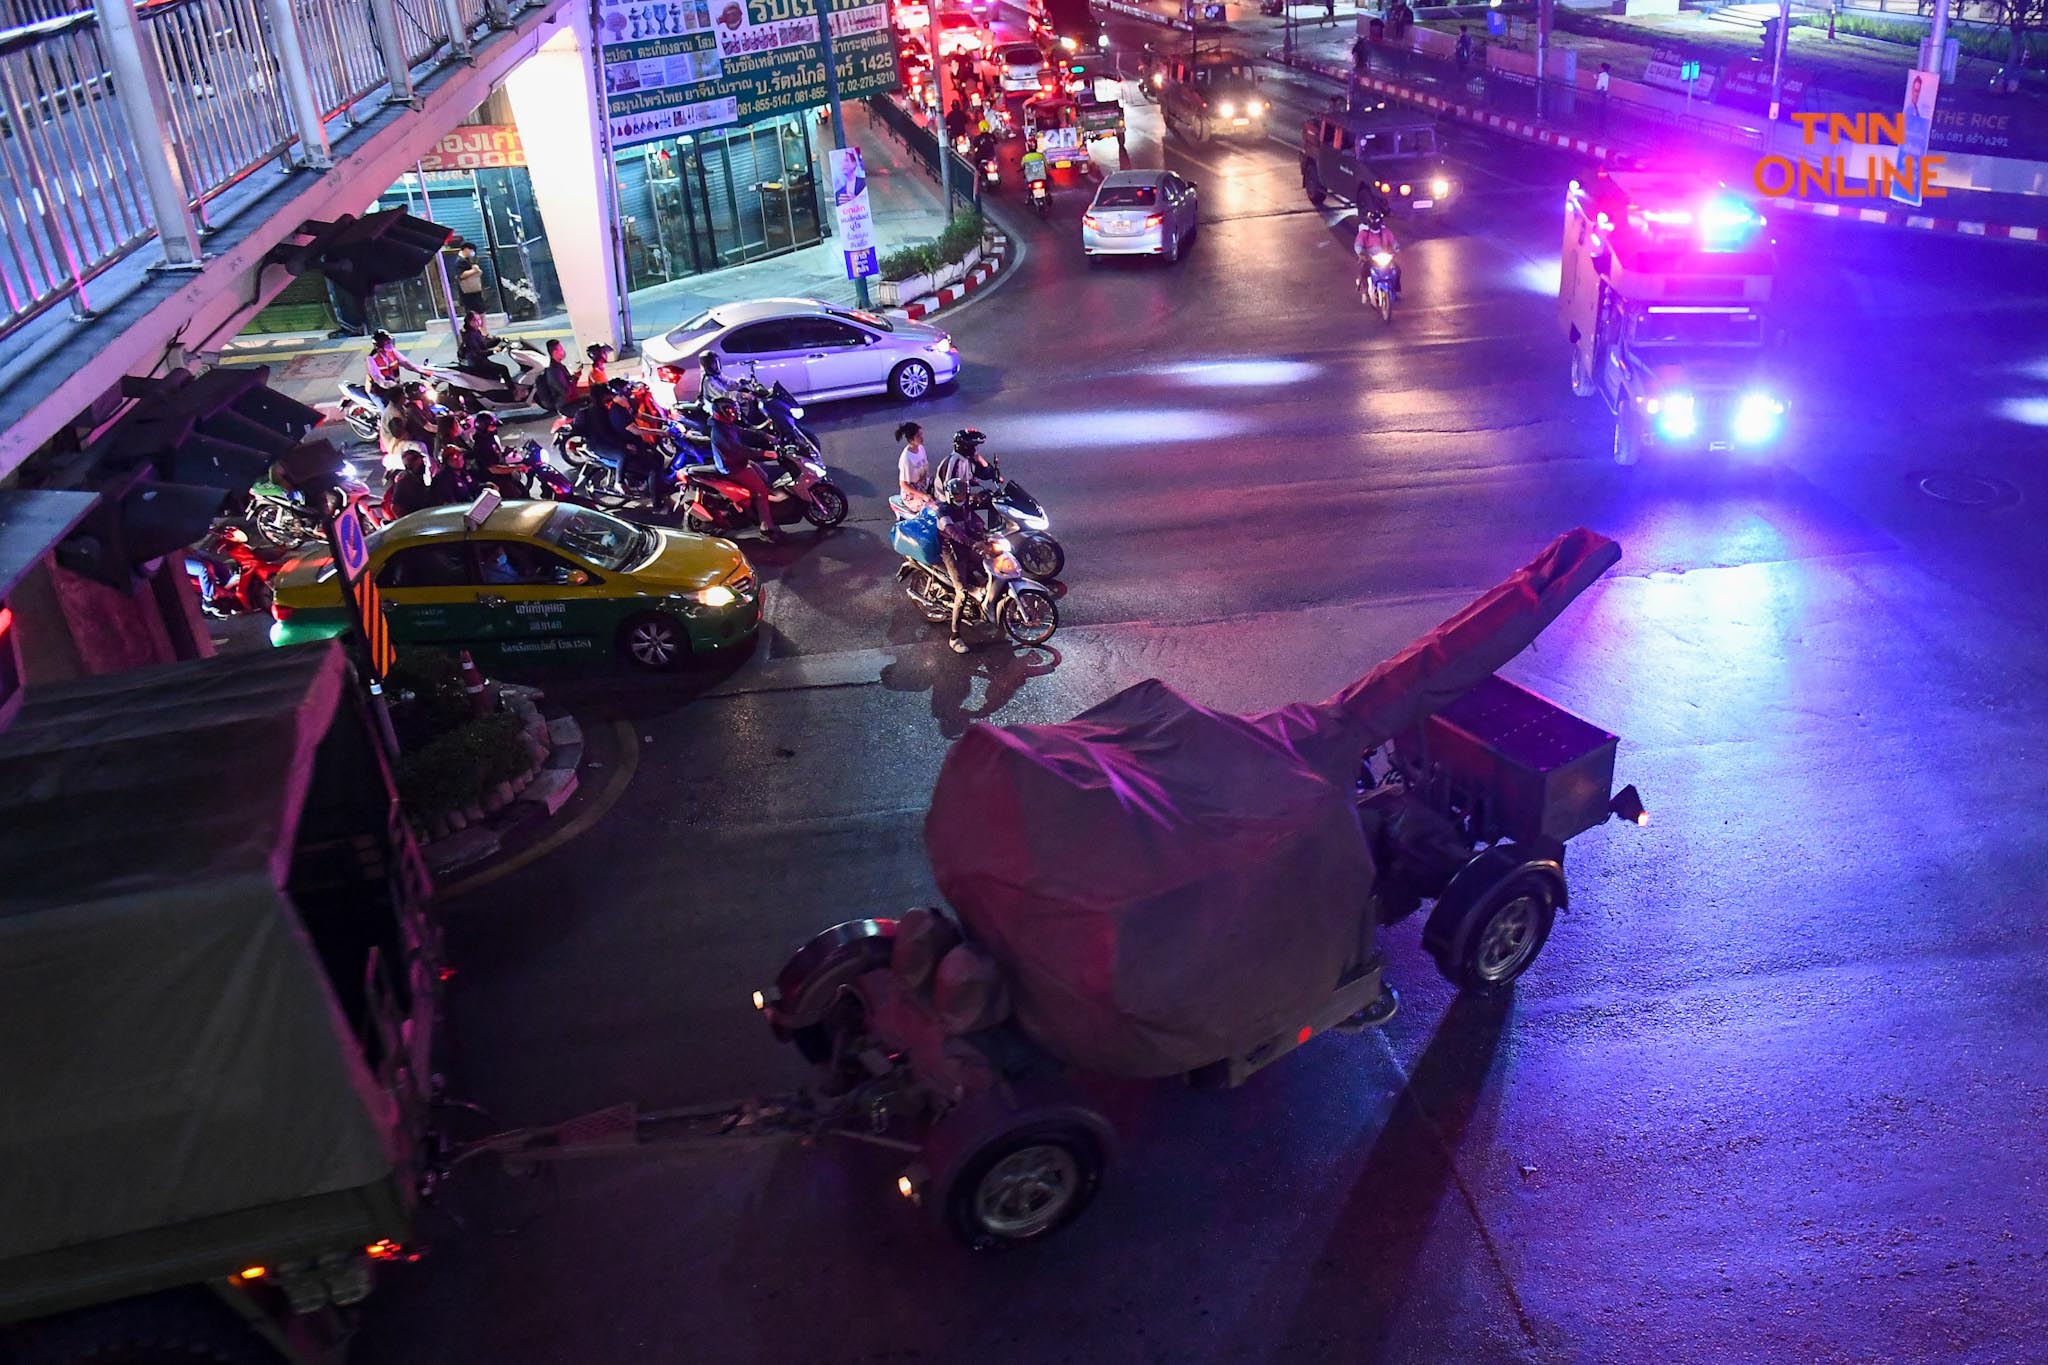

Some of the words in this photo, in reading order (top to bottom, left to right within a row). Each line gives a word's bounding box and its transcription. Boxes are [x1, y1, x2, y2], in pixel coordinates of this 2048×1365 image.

[861, 51, 892, 72] 1425
[1935, 110, 1967, 126] THE
[1971, 112, 2009, 130] RICE
